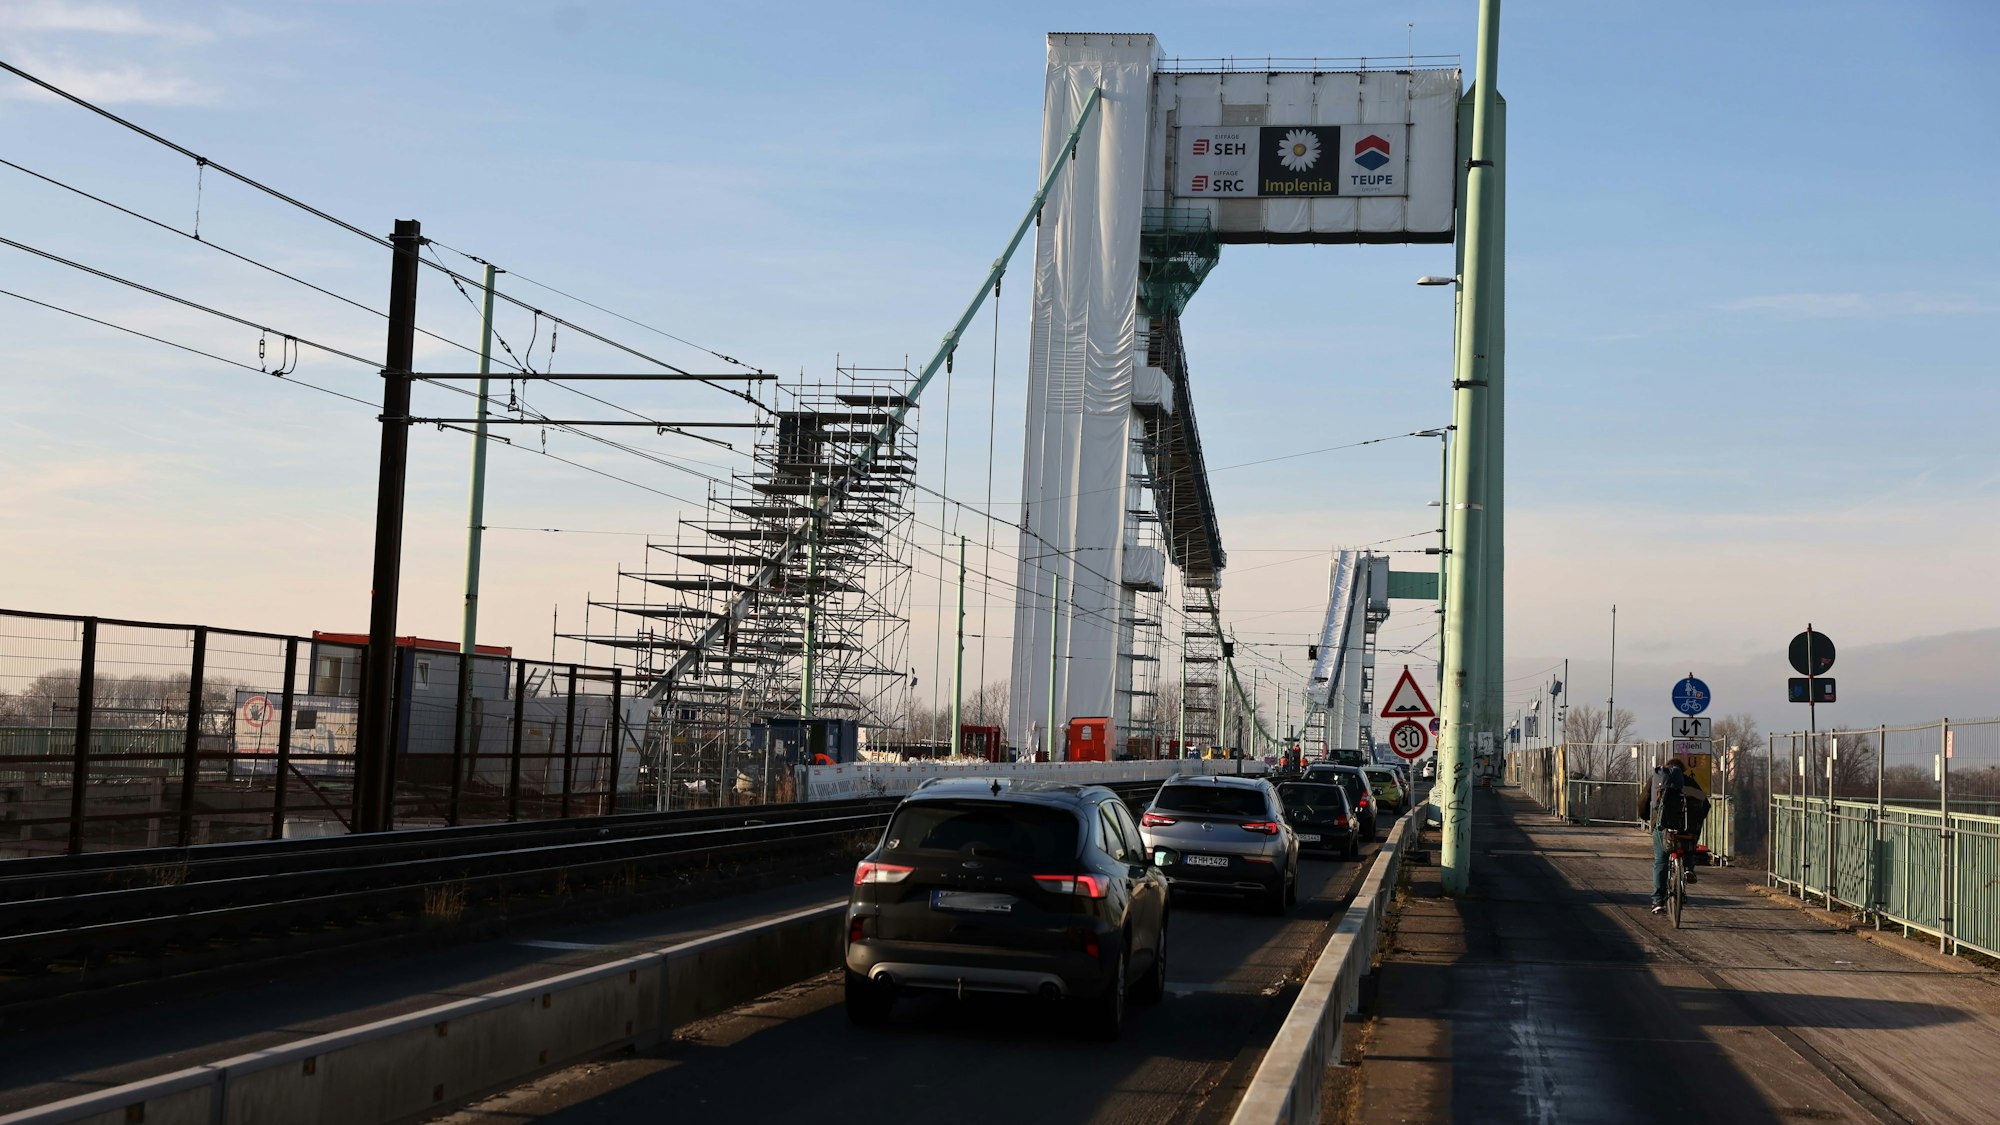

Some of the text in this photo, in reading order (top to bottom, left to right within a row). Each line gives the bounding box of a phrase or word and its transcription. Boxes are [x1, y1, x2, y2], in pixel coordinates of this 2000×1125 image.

[1214, 143, 1246, 155] SEH
[1213, 179, 1244, 192] SRC
[1265, 177, 1332, 195] Implenia
[1351, 175, 1393, 185] TEUPE
[1398, 730, 1420, 748] 30
[1682, 742, 1702, 750] Niehl
